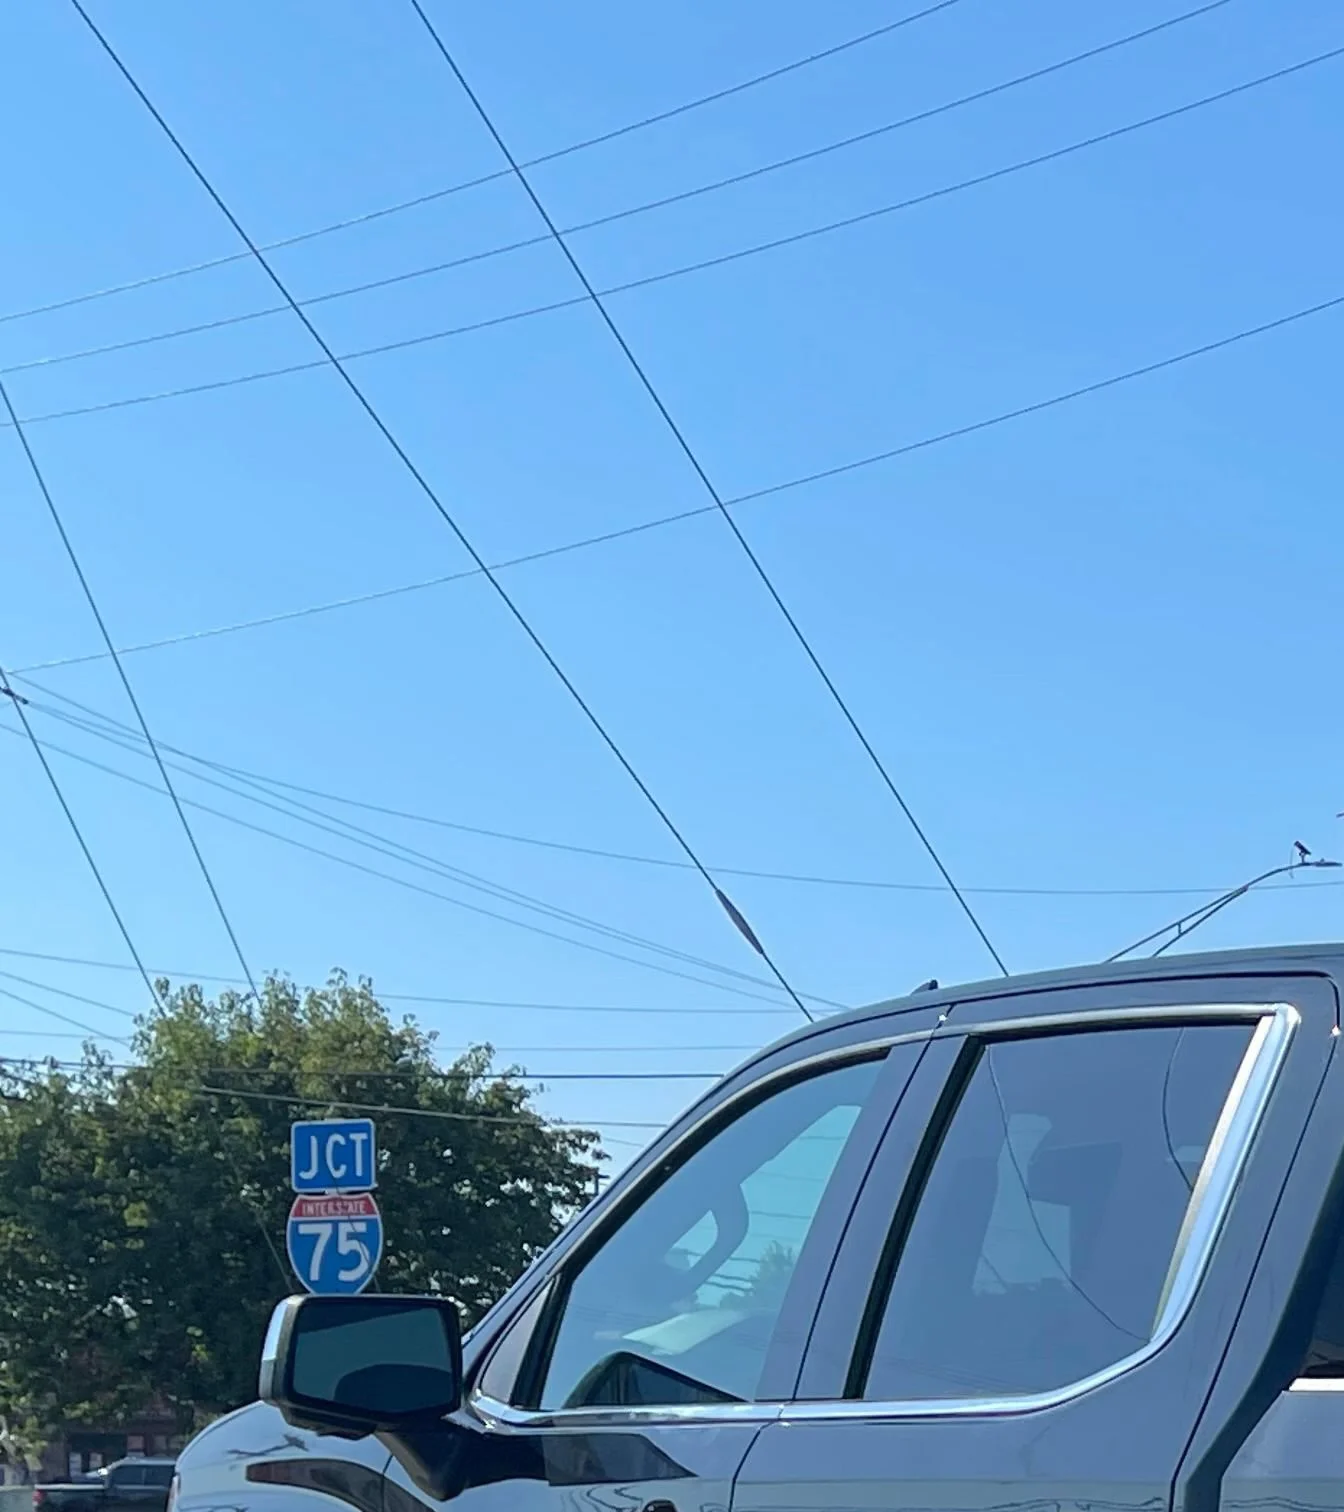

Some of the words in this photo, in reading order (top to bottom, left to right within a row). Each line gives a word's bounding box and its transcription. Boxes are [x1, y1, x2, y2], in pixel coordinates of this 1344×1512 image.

[299, 1132, 369, 1180] JCT
[302, 1201, 366, 1217] INTERSTATE
[298, 1222, 370, 1281] 75
